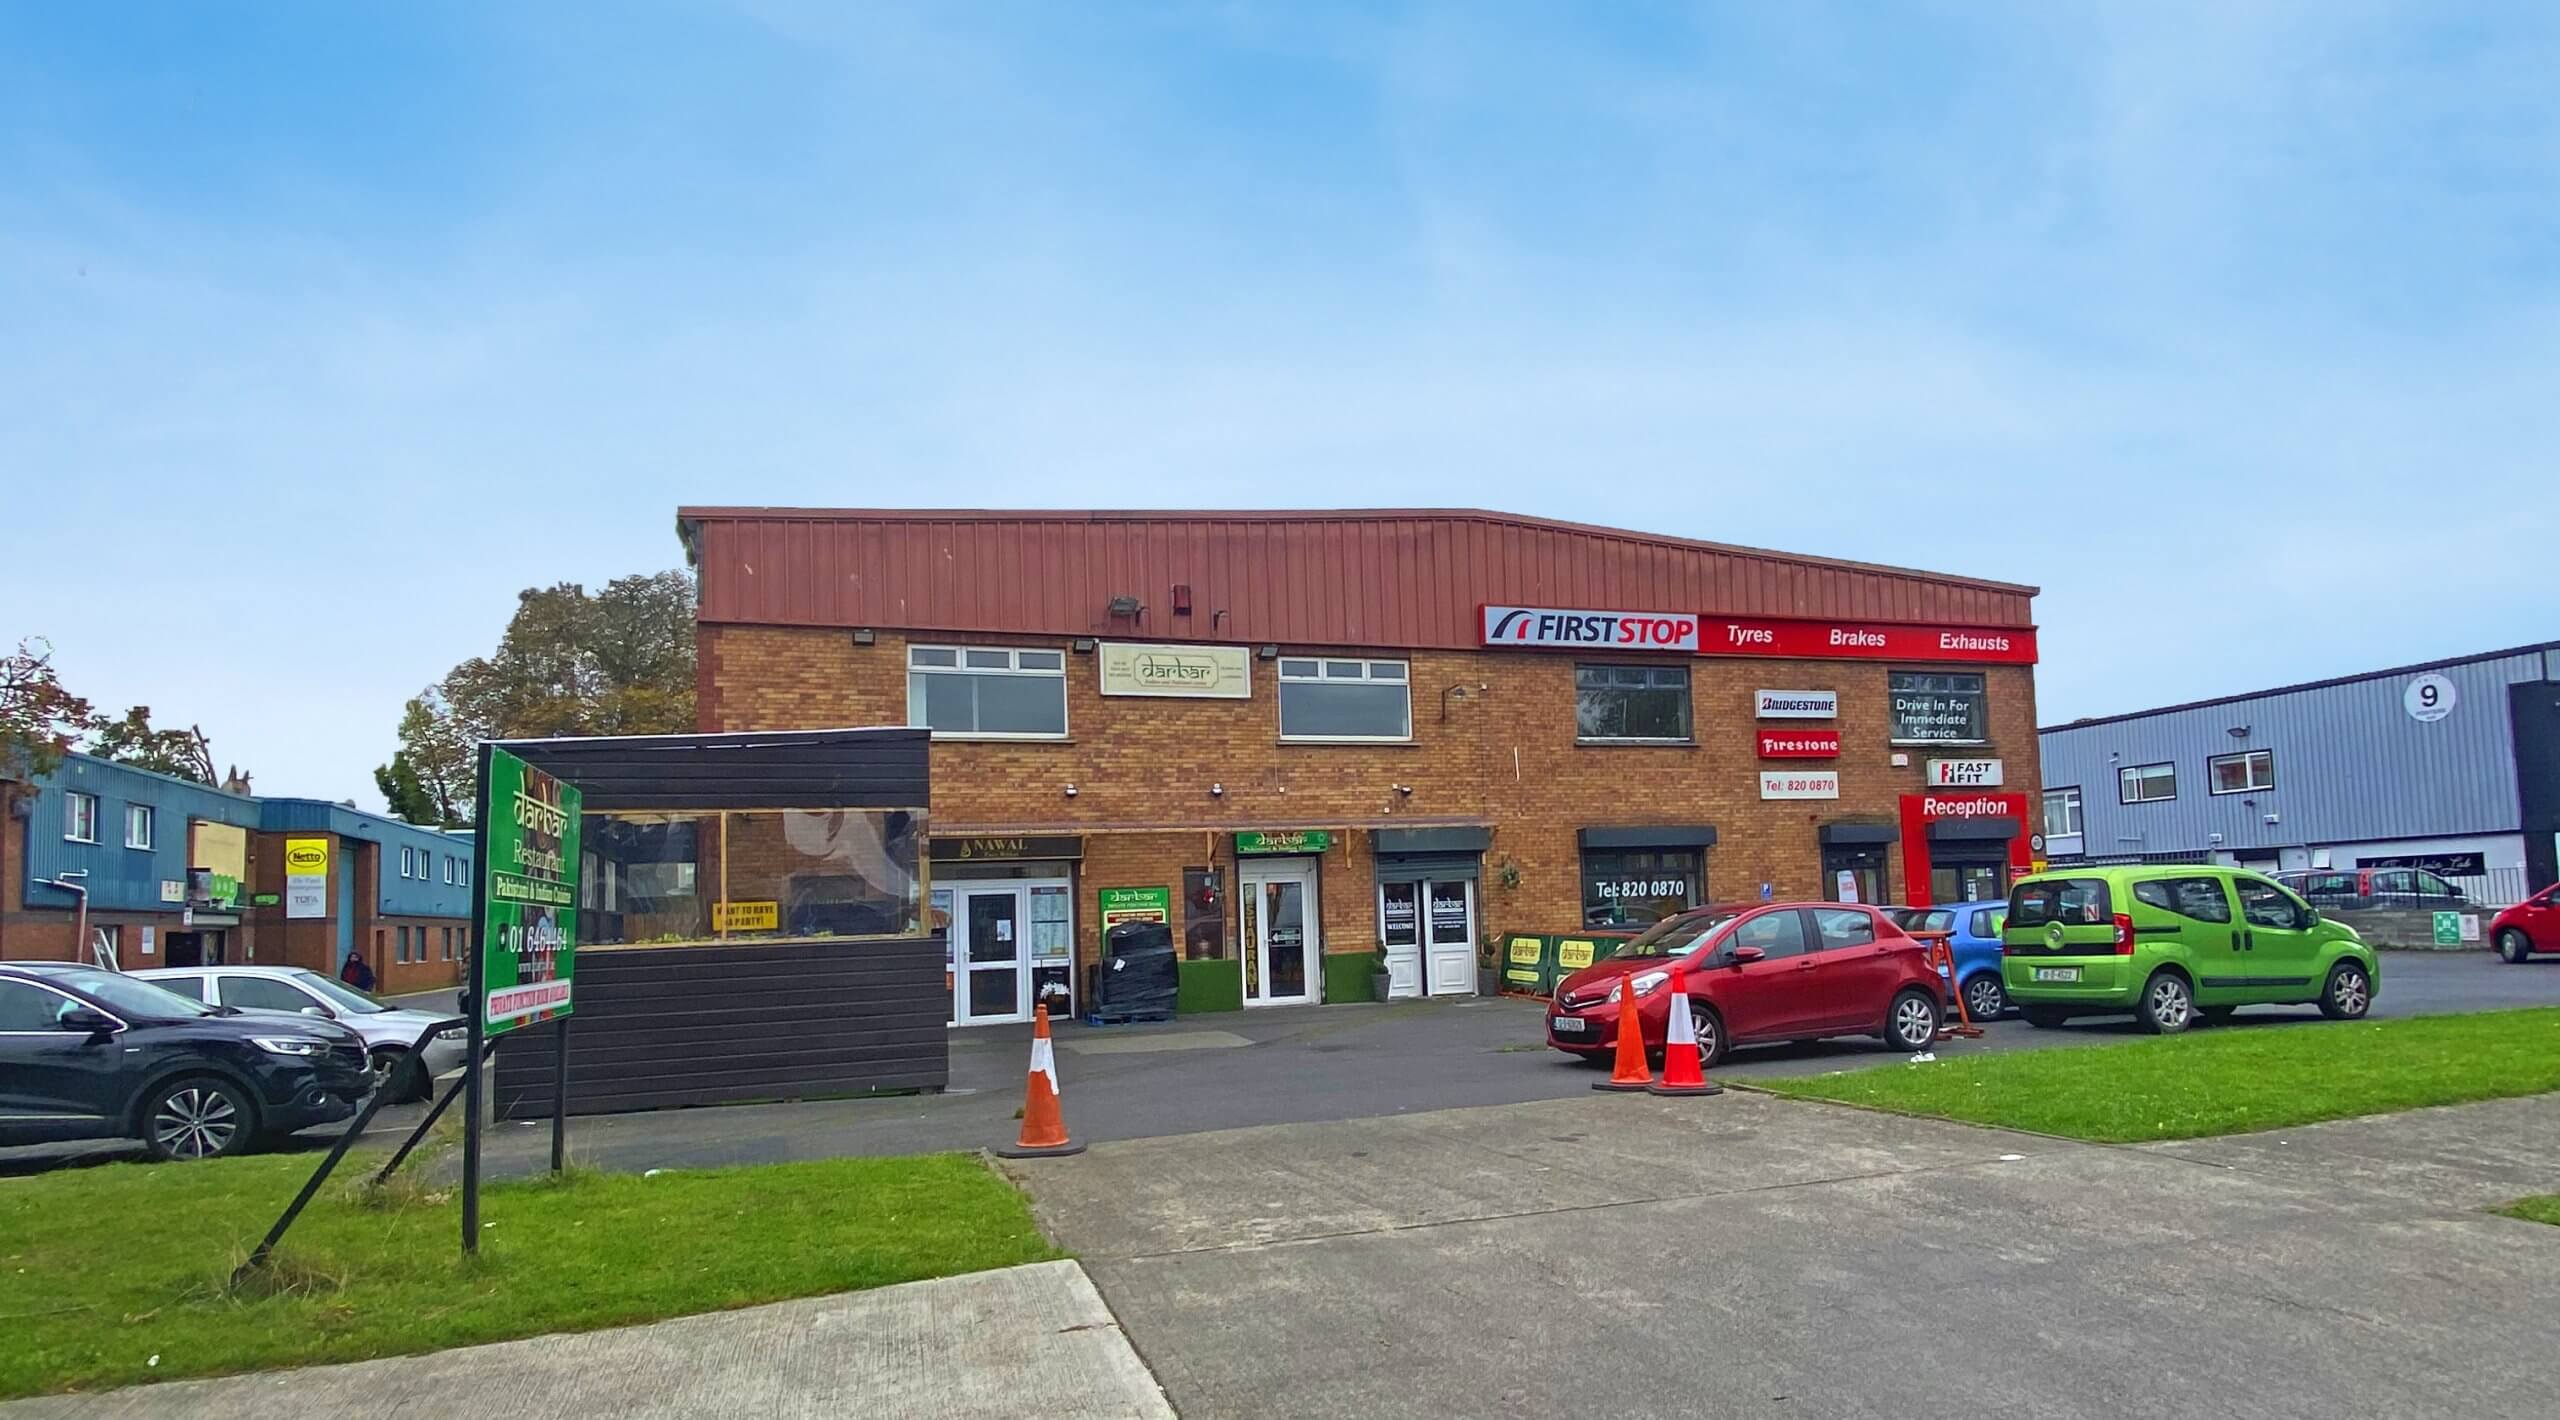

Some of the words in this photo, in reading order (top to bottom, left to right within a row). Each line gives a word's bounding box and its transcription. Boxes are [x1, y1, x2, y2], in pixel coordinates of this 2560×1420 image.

[1537, 614, 1694, 645] FIRSTSTOP
[1727, 624, 1774, 646] Tyres
[1829, 628, 1886, 647] Brakes
[1939, 632, 2010, 652] Exhausts
[1141, 655, 1212, 679] darbar
[2420, 684, 2439, 707] 9
[1761, 697, 1835, 711] BRIDGESTONE
[1896, 698, 1930, 711] Drive
[1933, 699, 1945, 711] In
[1949, 699, 1969, 712] For
[1900, 712, 1967, 725] Immediate
[1912, 726, 1957, 739] Service
[1762, 738, 1838, 754] Firestone
[1957, 762, 1992, 773] FAST
[1765, 780, 1784, 792] Tel:
[1787, 780, 1807, 792] 820
[1809, 780, 1835, 792] 0870
[1957, 773, 1983, 784] FIT
[512, 770, 569, 840] darbar
[1923, 797, 2008, 819] Reception
[974, 839, 1028, 851] NAWAL
[293, 852, 321, 862] Netto
[512, 838, 567, 874] Restaurant
[1595, 881, 1620, 898] Tel:
[1621, 881, 1647, 897] 820
[1650, 880, 1684, 897] 0870
[742, 906, 752, 914] TO
[2086, 904, 2099, 921] N
[509, 925, 524, 953] 01
